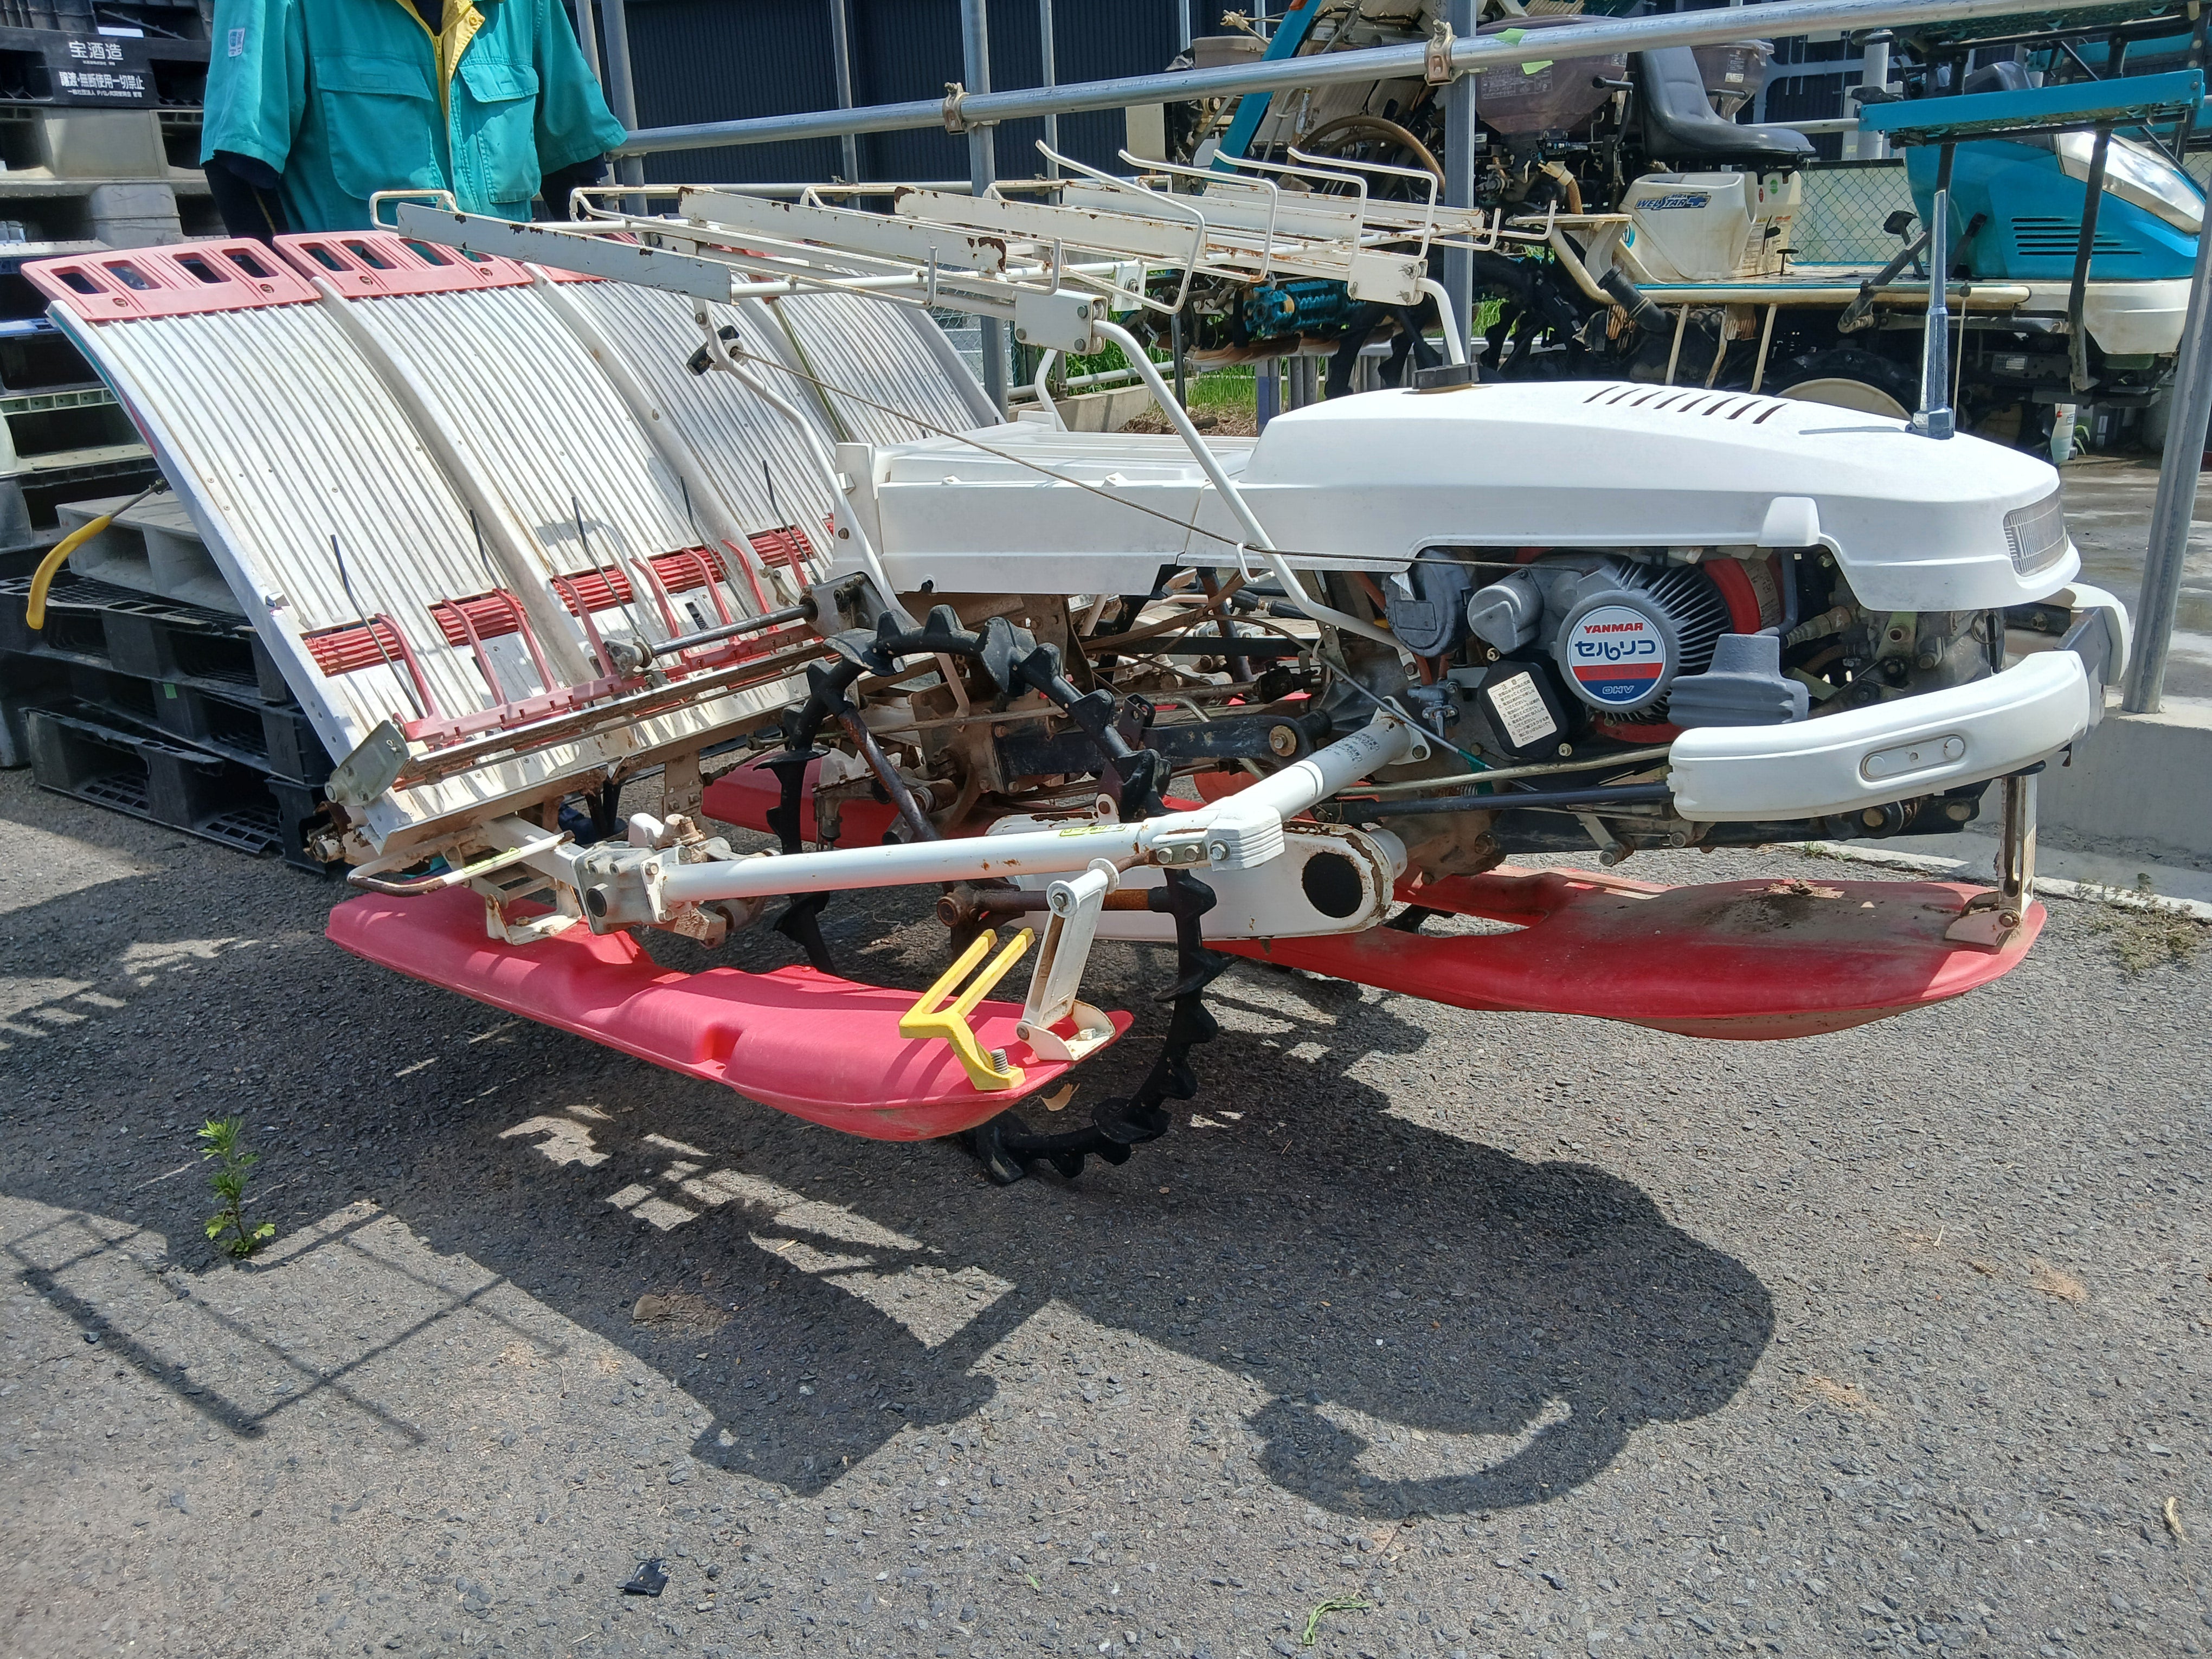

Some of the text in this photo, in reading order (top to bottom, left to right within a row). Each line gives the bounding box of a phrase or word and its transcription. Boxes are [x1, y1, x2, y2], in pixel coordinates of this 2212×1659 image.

[69, 41, 124, 60] 宝酒造
[1636, 196, 1687, 209] WELSTAR
[1583, 622, 1643, 634] YANMAR
[1602, 685, 1635, 695] OHV
